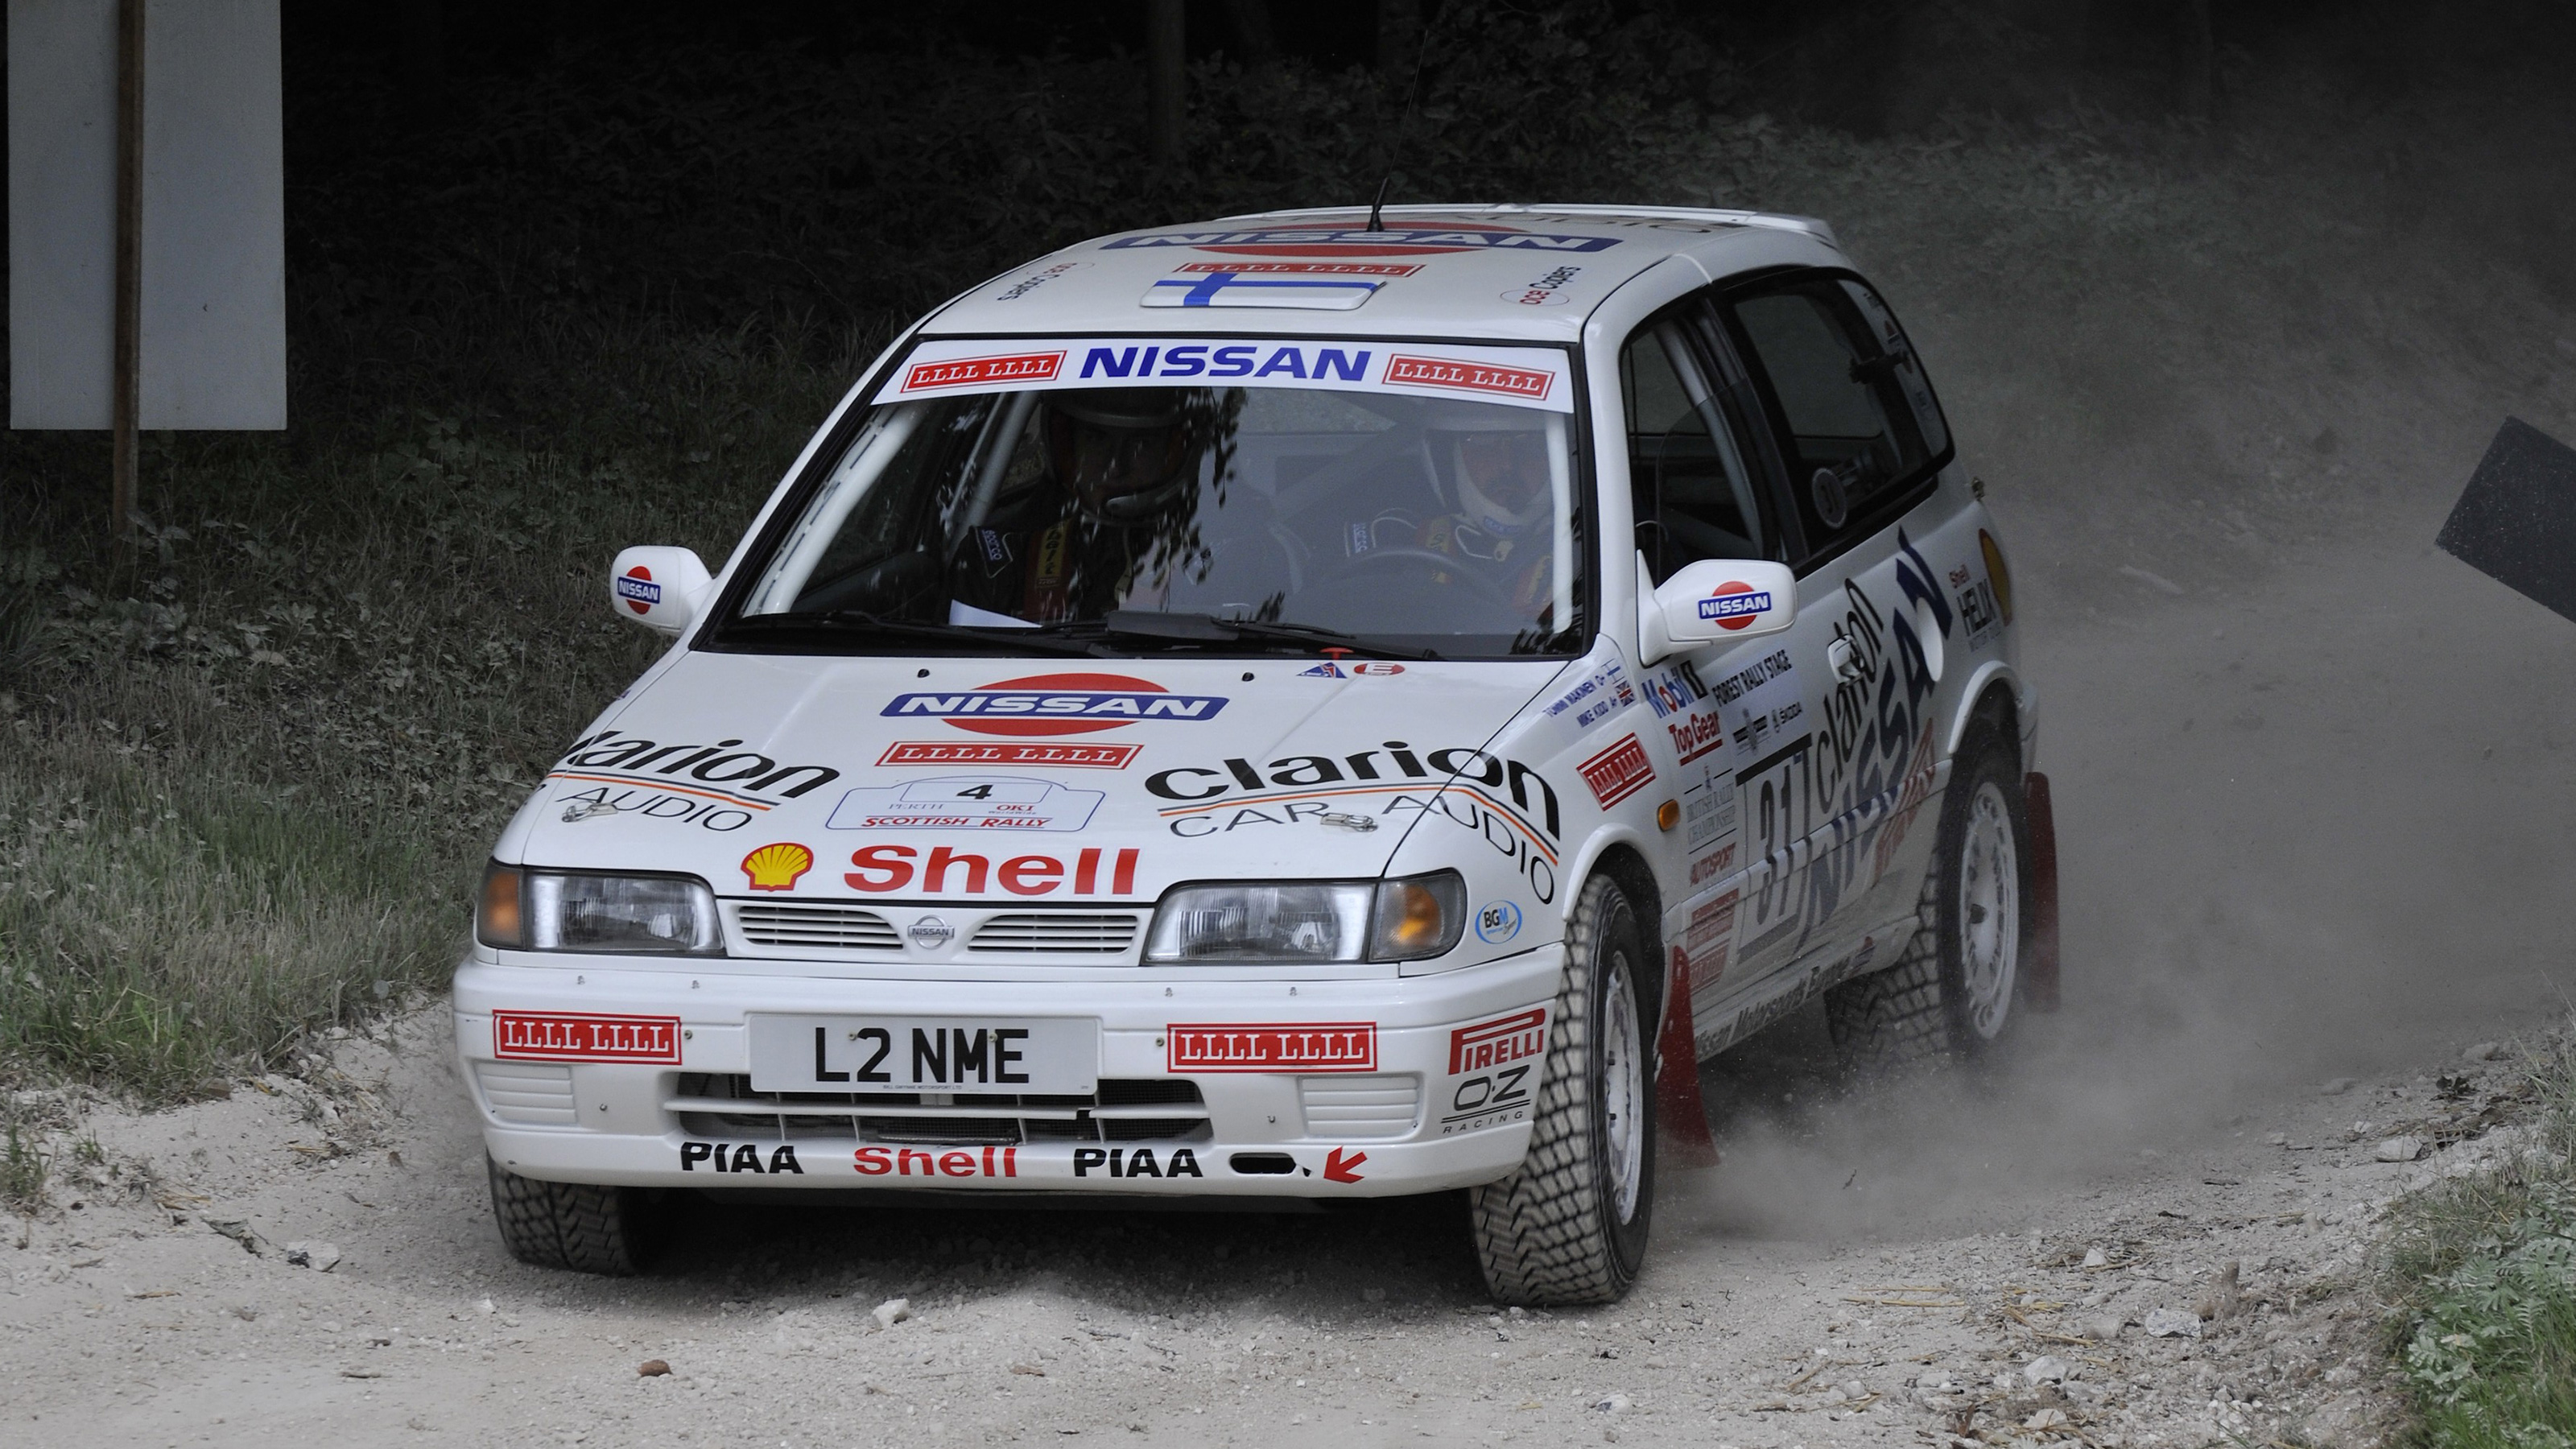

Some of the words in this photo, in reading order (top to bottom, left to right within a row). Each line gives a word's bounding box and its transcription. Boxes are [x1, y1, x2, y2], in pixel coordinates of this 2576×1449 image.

[1128, 231, 1593, 250] NISSAN
[1529, 266, 1581, 289] Copiers
[914, 365, 979, 385] LLLL
[985, 359, 1053, 378] LLLL
[1079, 346, 1372, 382] NISSAN
[1395, 362, 1464, 382] LLLL
[1471, 371, 1540, 392] LLLL
[619, 580, 659, 601] NISSAN
[1700, 595, 1769, 617] NISSAN
[1641, 665, 1695, 719] Mobil
[1712, 675, 1744, 707] FOREST
[1740, 661, 1769, 692] RALLY
[1764, 649, 1793, 679] STAGE
[899, 696, 1211, 716] NISSAN
[564, 731, 840, 799] larion
[897, 747, 1001, 760] LLLL
[1013, 749, 1117, 762] LLLL
[956, 784, 994, 799] 4
[1145, 741, 1560, 841] clarion
[556, 786, 753, 832] AUDIO
[861, 816, 970, 828] SCOTTISH
[980, 818, 1051, 828] RALLY
[1170, 801, 1333, 838] CAR
[1381, 795, 1554, 905] AUDIO
[1690, 842, 1736, 887] AUTOSPORT
[844, 845, 1140, 895] Shell
[912, 927, 951, 937] NISSAN
[1483, 907, 1509, 928] BGM
[505, 1021, 581, 1050] LLLL
[590, 1024, 670, 1052] LLLL
[1180, 1033, 1267, 1061] LLLL
[1277, 1032, 1364, 1060] LLLL
[1447, 1008, 1546, 1075] PIRELLI
[815, 1027, 891, 1083] L2
[911, 1028, 1030, 1084] NME
[1443, 1110, 1524, 1133] RACING
[680, 1141, 804, 1174] PIAA
[853, 1146, 1018, 1178] Shell
[1073, 1148, 1204, 1179] PIAA
